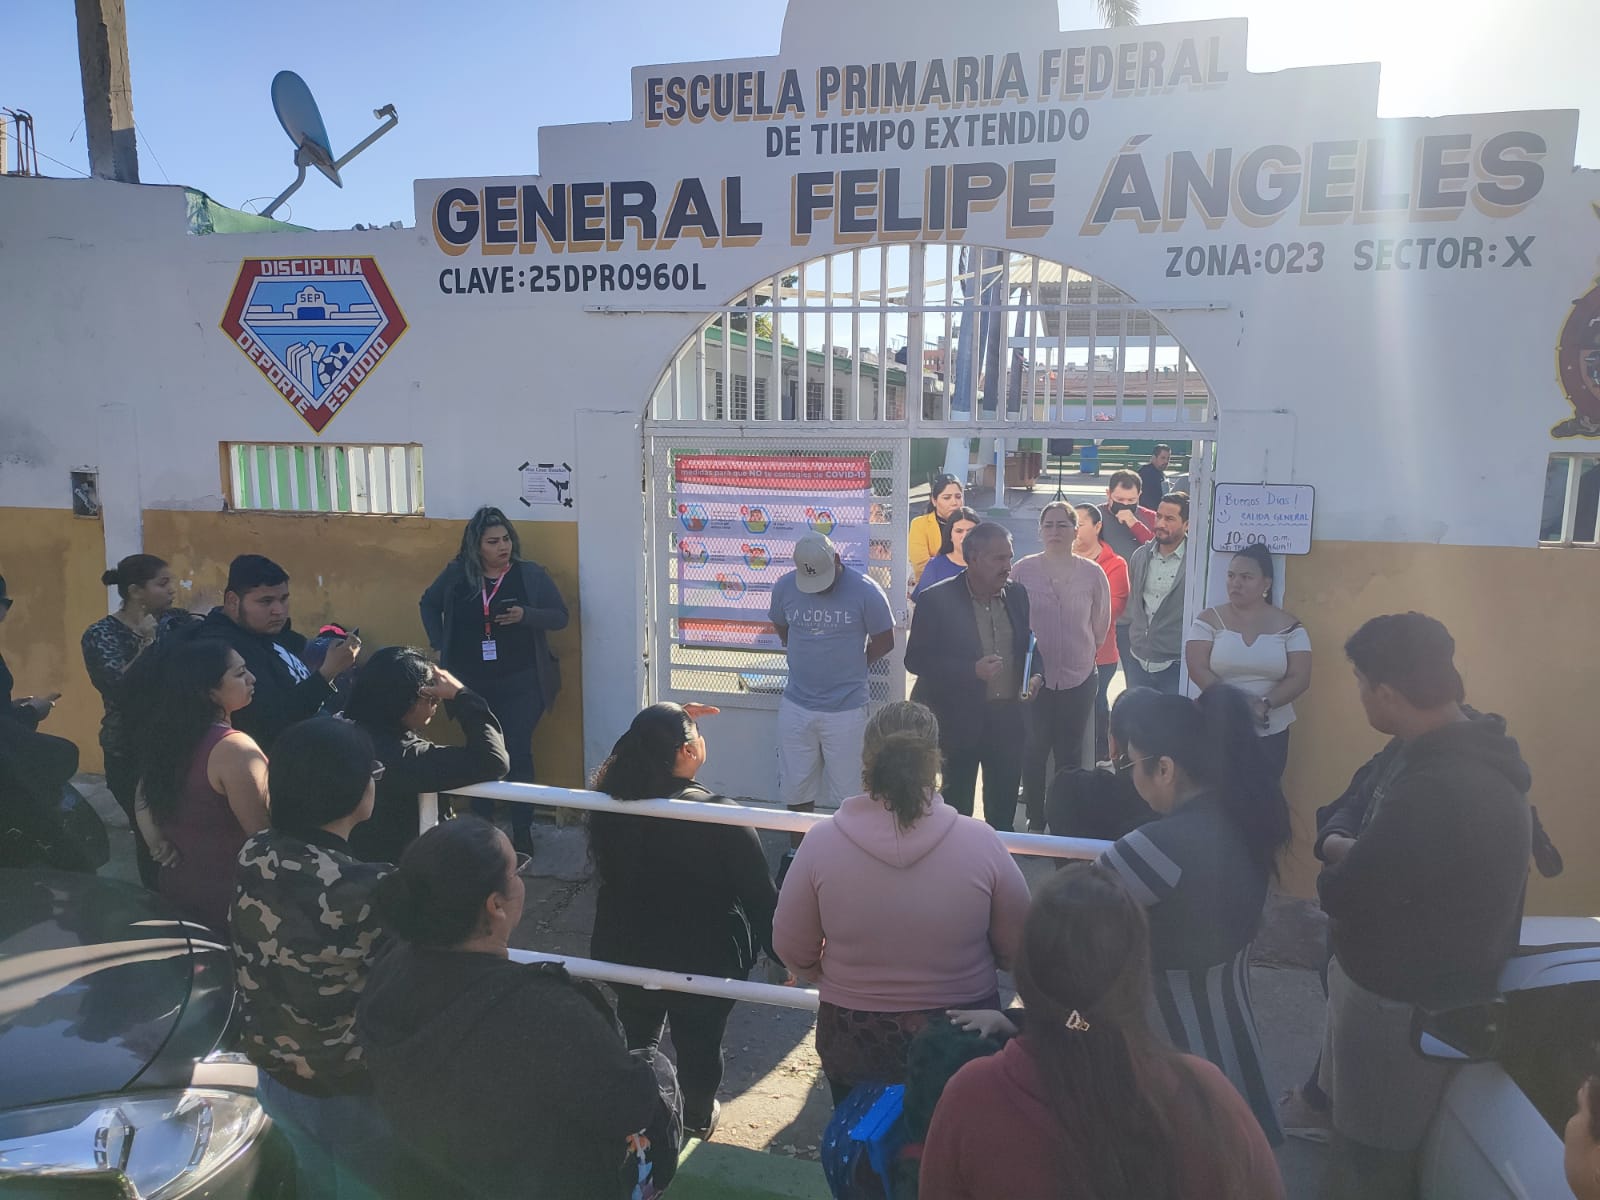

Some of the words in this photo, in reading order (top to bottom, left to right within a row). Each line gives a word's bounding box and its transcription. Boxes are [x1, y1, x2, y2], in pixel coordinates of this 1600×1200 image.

[645, 70, 804, 126] ESCUELA
[817, 53, 1028, 116] PRIMARIA
[1039, 37, 1228, 101] FEDERAL
[766, 124, 801, 158] DE
[811, 119, 915, 155] TIEMPO
[925, 108, 1089, 150] EXTENDIDO
[432, 177, 763, 256] GENERAL
[791, 158, 1056, 246] FELIPE
[1079, 131, 1548, 235] ÁNGELES
[260, 259, 363, 276] DISCIPLINA
[1166, 242, 1325, 278] ZONA:023
[299, 293, 321, 303] SEP
[236, 330, 310, 415] DEPORTE
[323, 336, 389, 414] ESTUDIO
[681, 469, 713, 477] medidas
[715, 470, 731, 479] para
[733, 471, 747, 479] que
[825, 471, 866, 479] COVID-19
[1274, 513, 1309, 521] GENERAL
